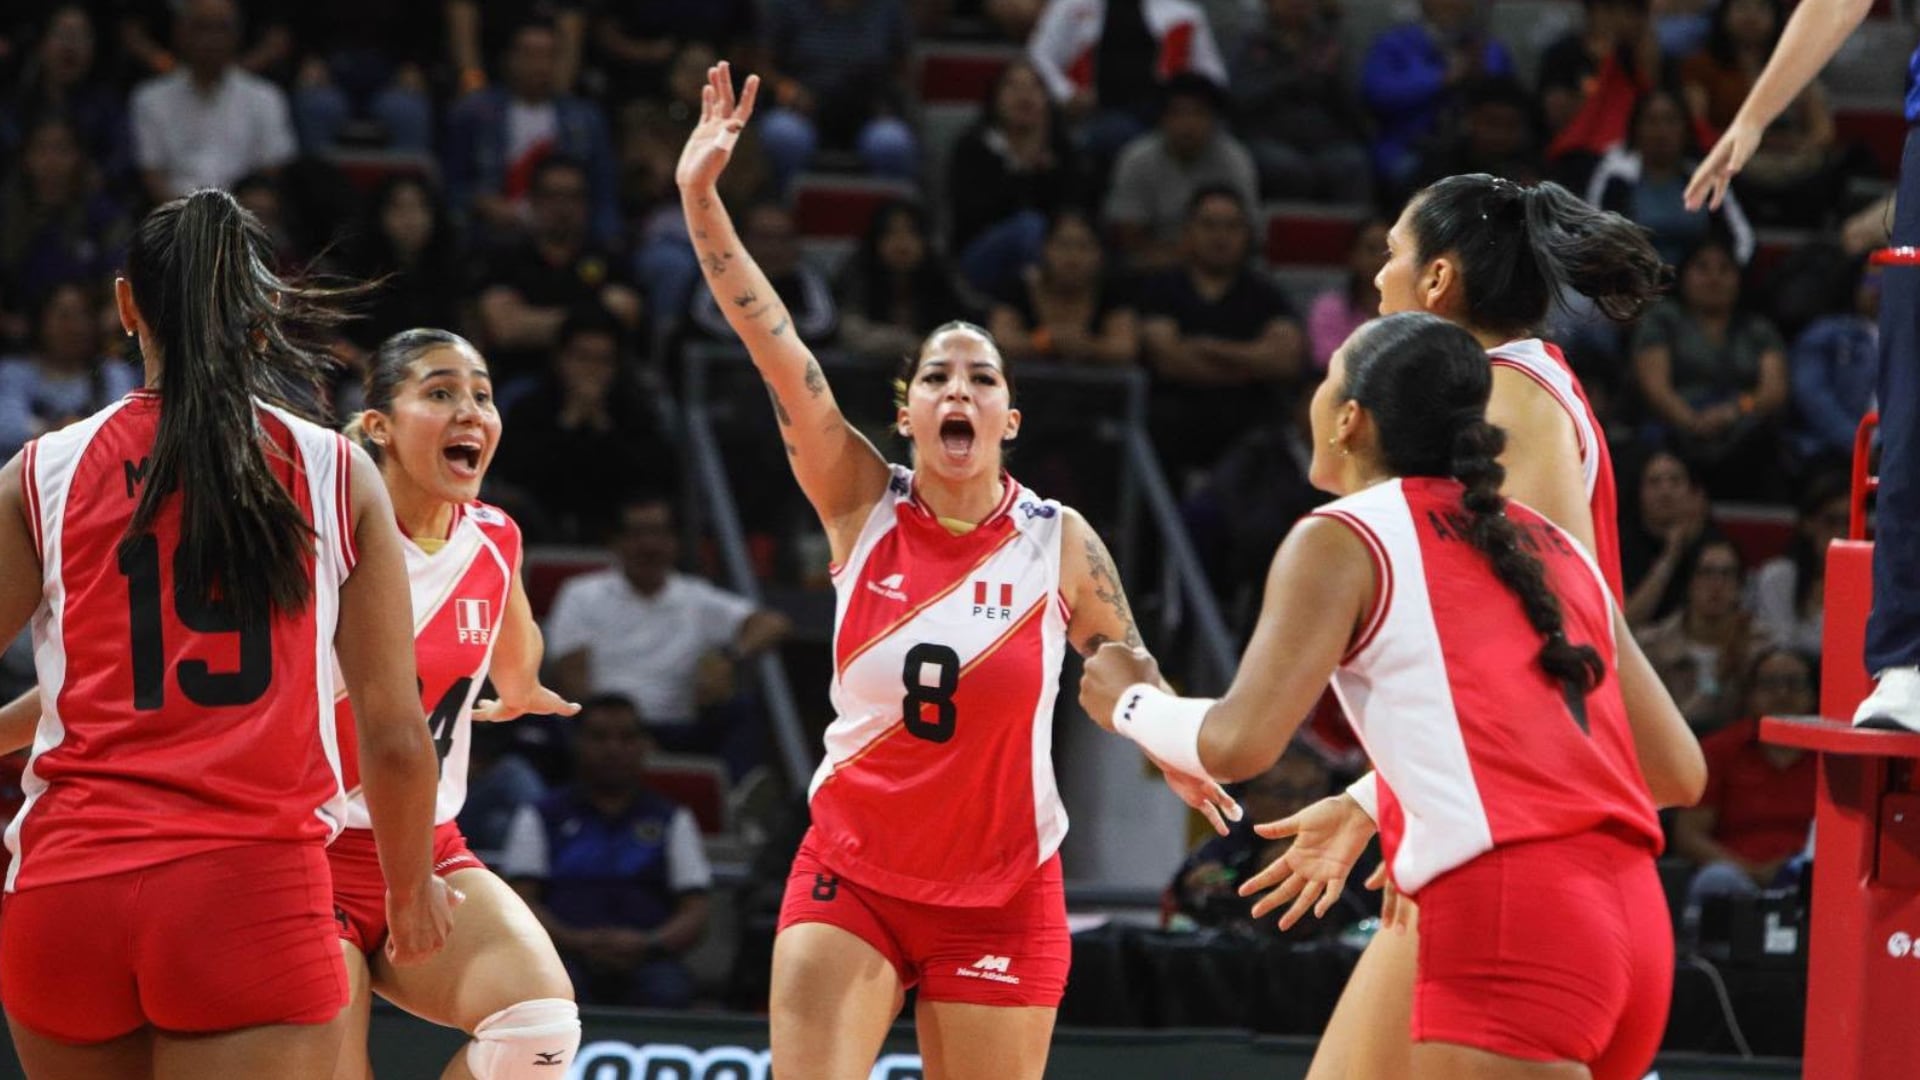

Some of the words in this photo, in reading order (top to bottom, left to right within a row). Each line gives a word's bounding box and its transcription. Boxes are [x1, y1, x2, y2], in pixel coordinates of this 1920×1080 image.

[118, 533, 273, 711] 19
[458, 630, 489, 645] PER
[973, 606, 1010, 620] PER
[902, 642, 960, 744] 8
[417, 675, 474, 782] 4
[956, 967, 980, 977] New
[980, 971, 1019, 984] Athletic
